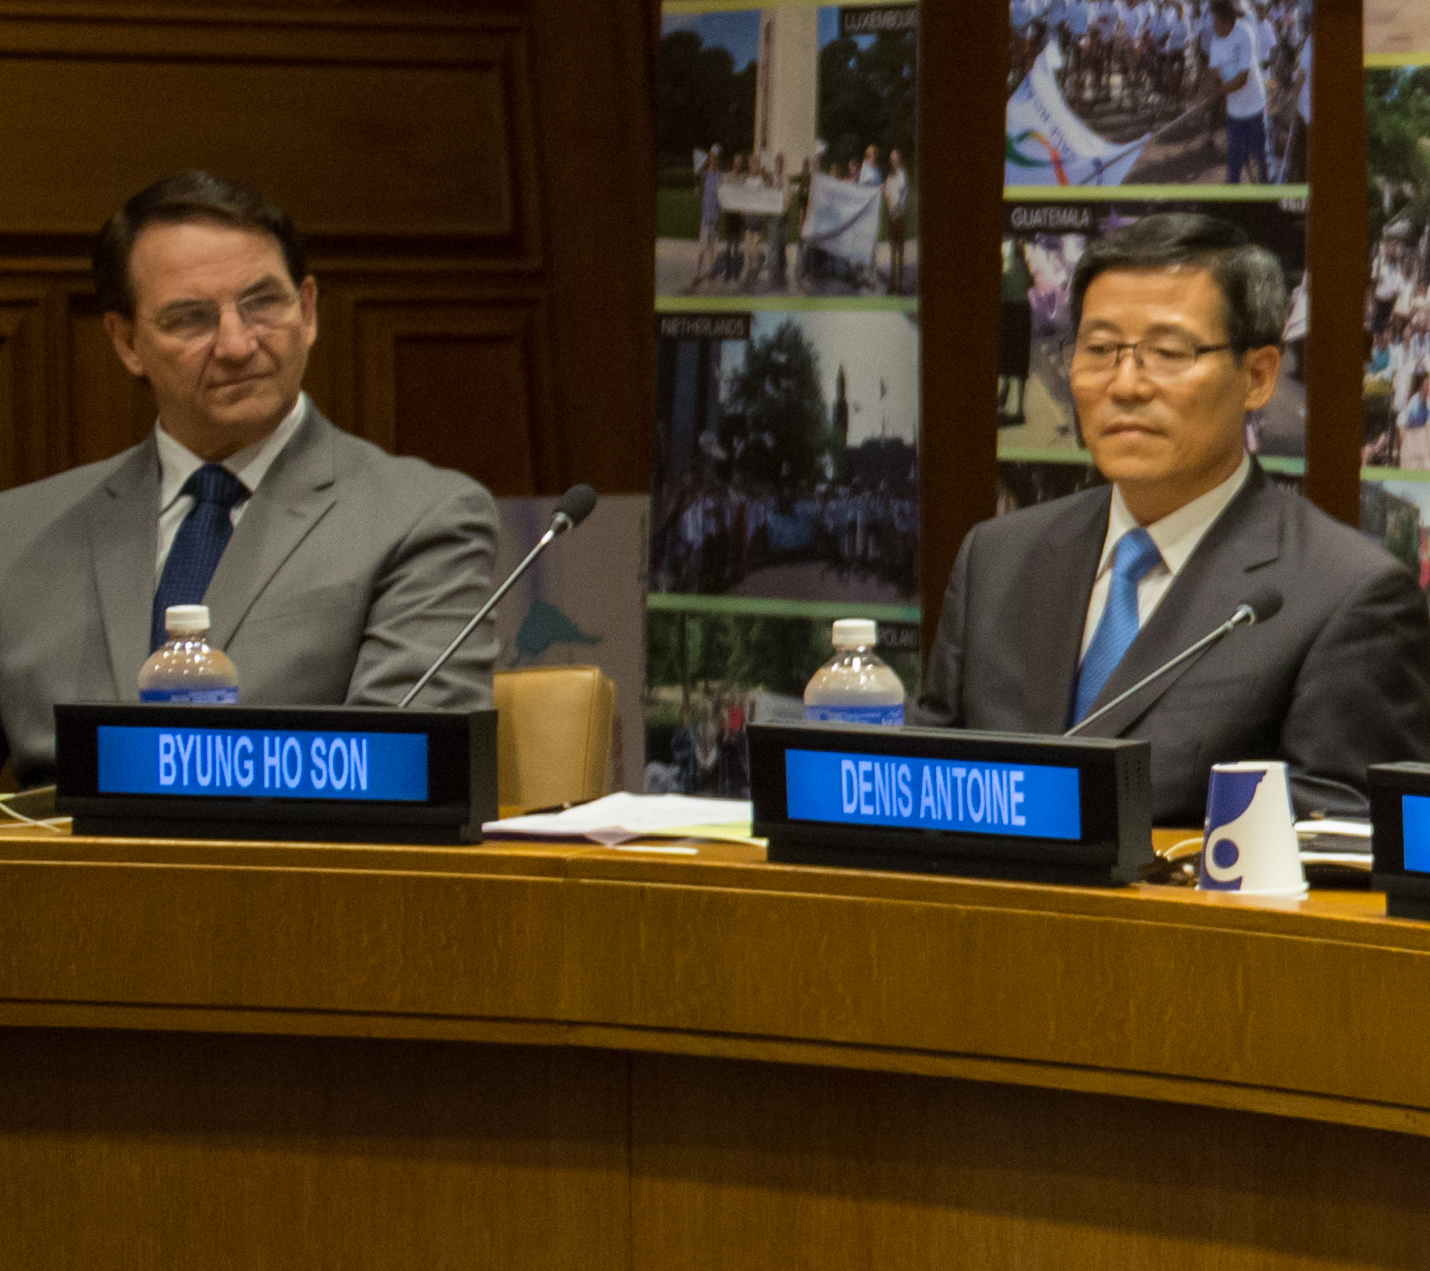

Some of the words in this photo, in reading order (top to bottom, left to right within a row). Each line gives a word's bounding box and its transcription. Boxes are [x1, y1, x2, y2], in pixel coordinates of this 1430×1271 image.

[1011, 206, 1090, 227] GUATEMALA
[159, 733, 254, 788] BYUNG
[263, 736, 302, 789] HO
[310, 737, 368, 791] SON
[841, 759, 913, 818] DENIS
[920, 765, 1026, 826] ANTOINE
